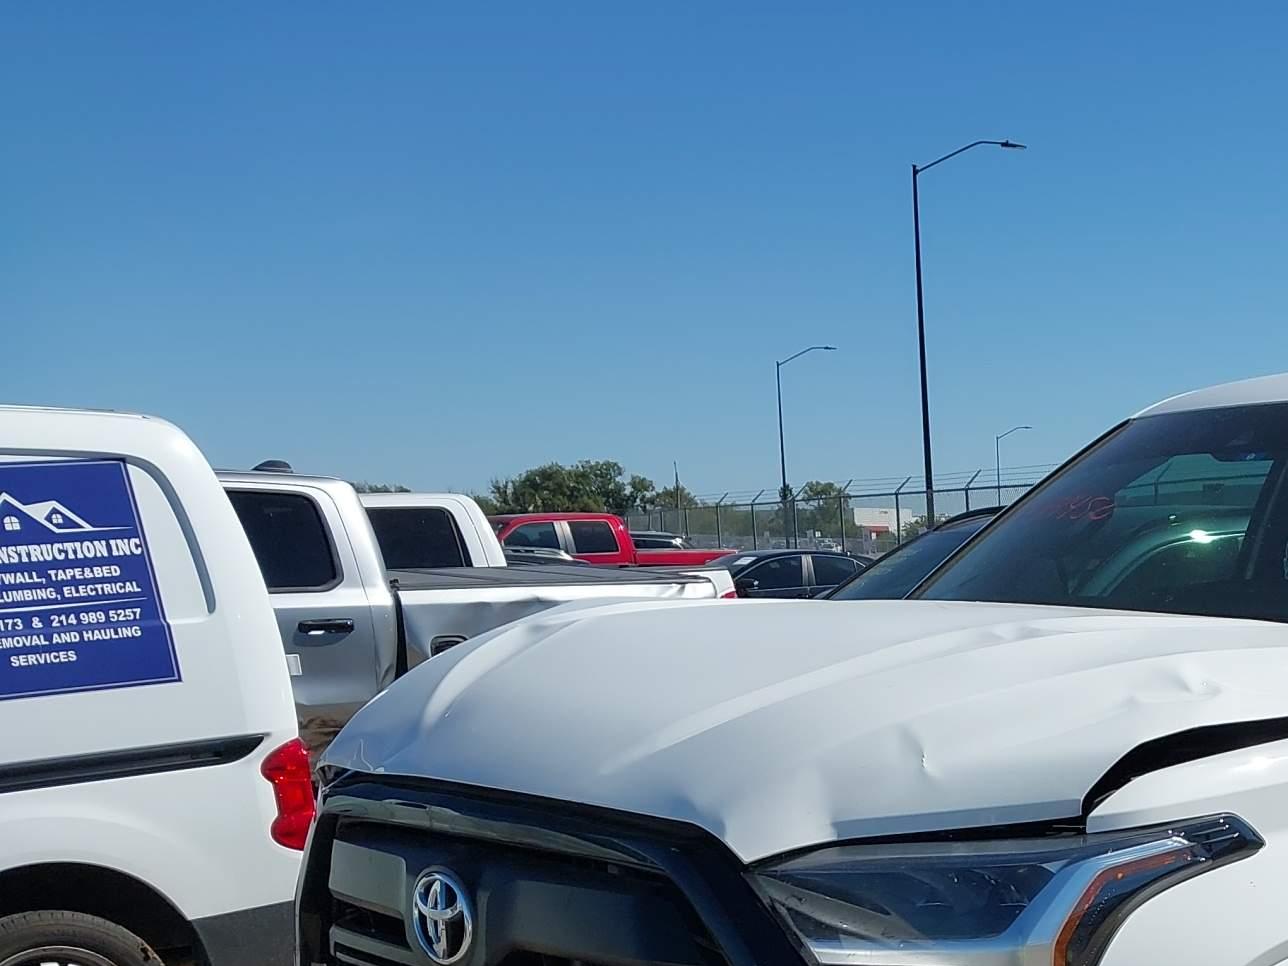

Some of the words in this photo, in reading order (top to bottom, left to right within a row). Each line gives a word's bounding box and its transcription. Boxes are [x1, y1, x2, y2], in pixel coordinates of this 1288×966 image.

[110, 538, 141, 556] INC
[0, 571, 46, 584] WALL,
[48, 565, 120, 581] TAPE&BED
[63, 581, 141, 597] ELECTRICAL
[31, 617, 43, 628] &
[50, 613, 77, 627] 214
[79, 612, 105, 624] 989
[108, 608, 141, 621] 5257
[52, 632, 79, 644] AND
[83, 626, 141, 641] HAULING
[10, 651, 77, 667] SERVICES
